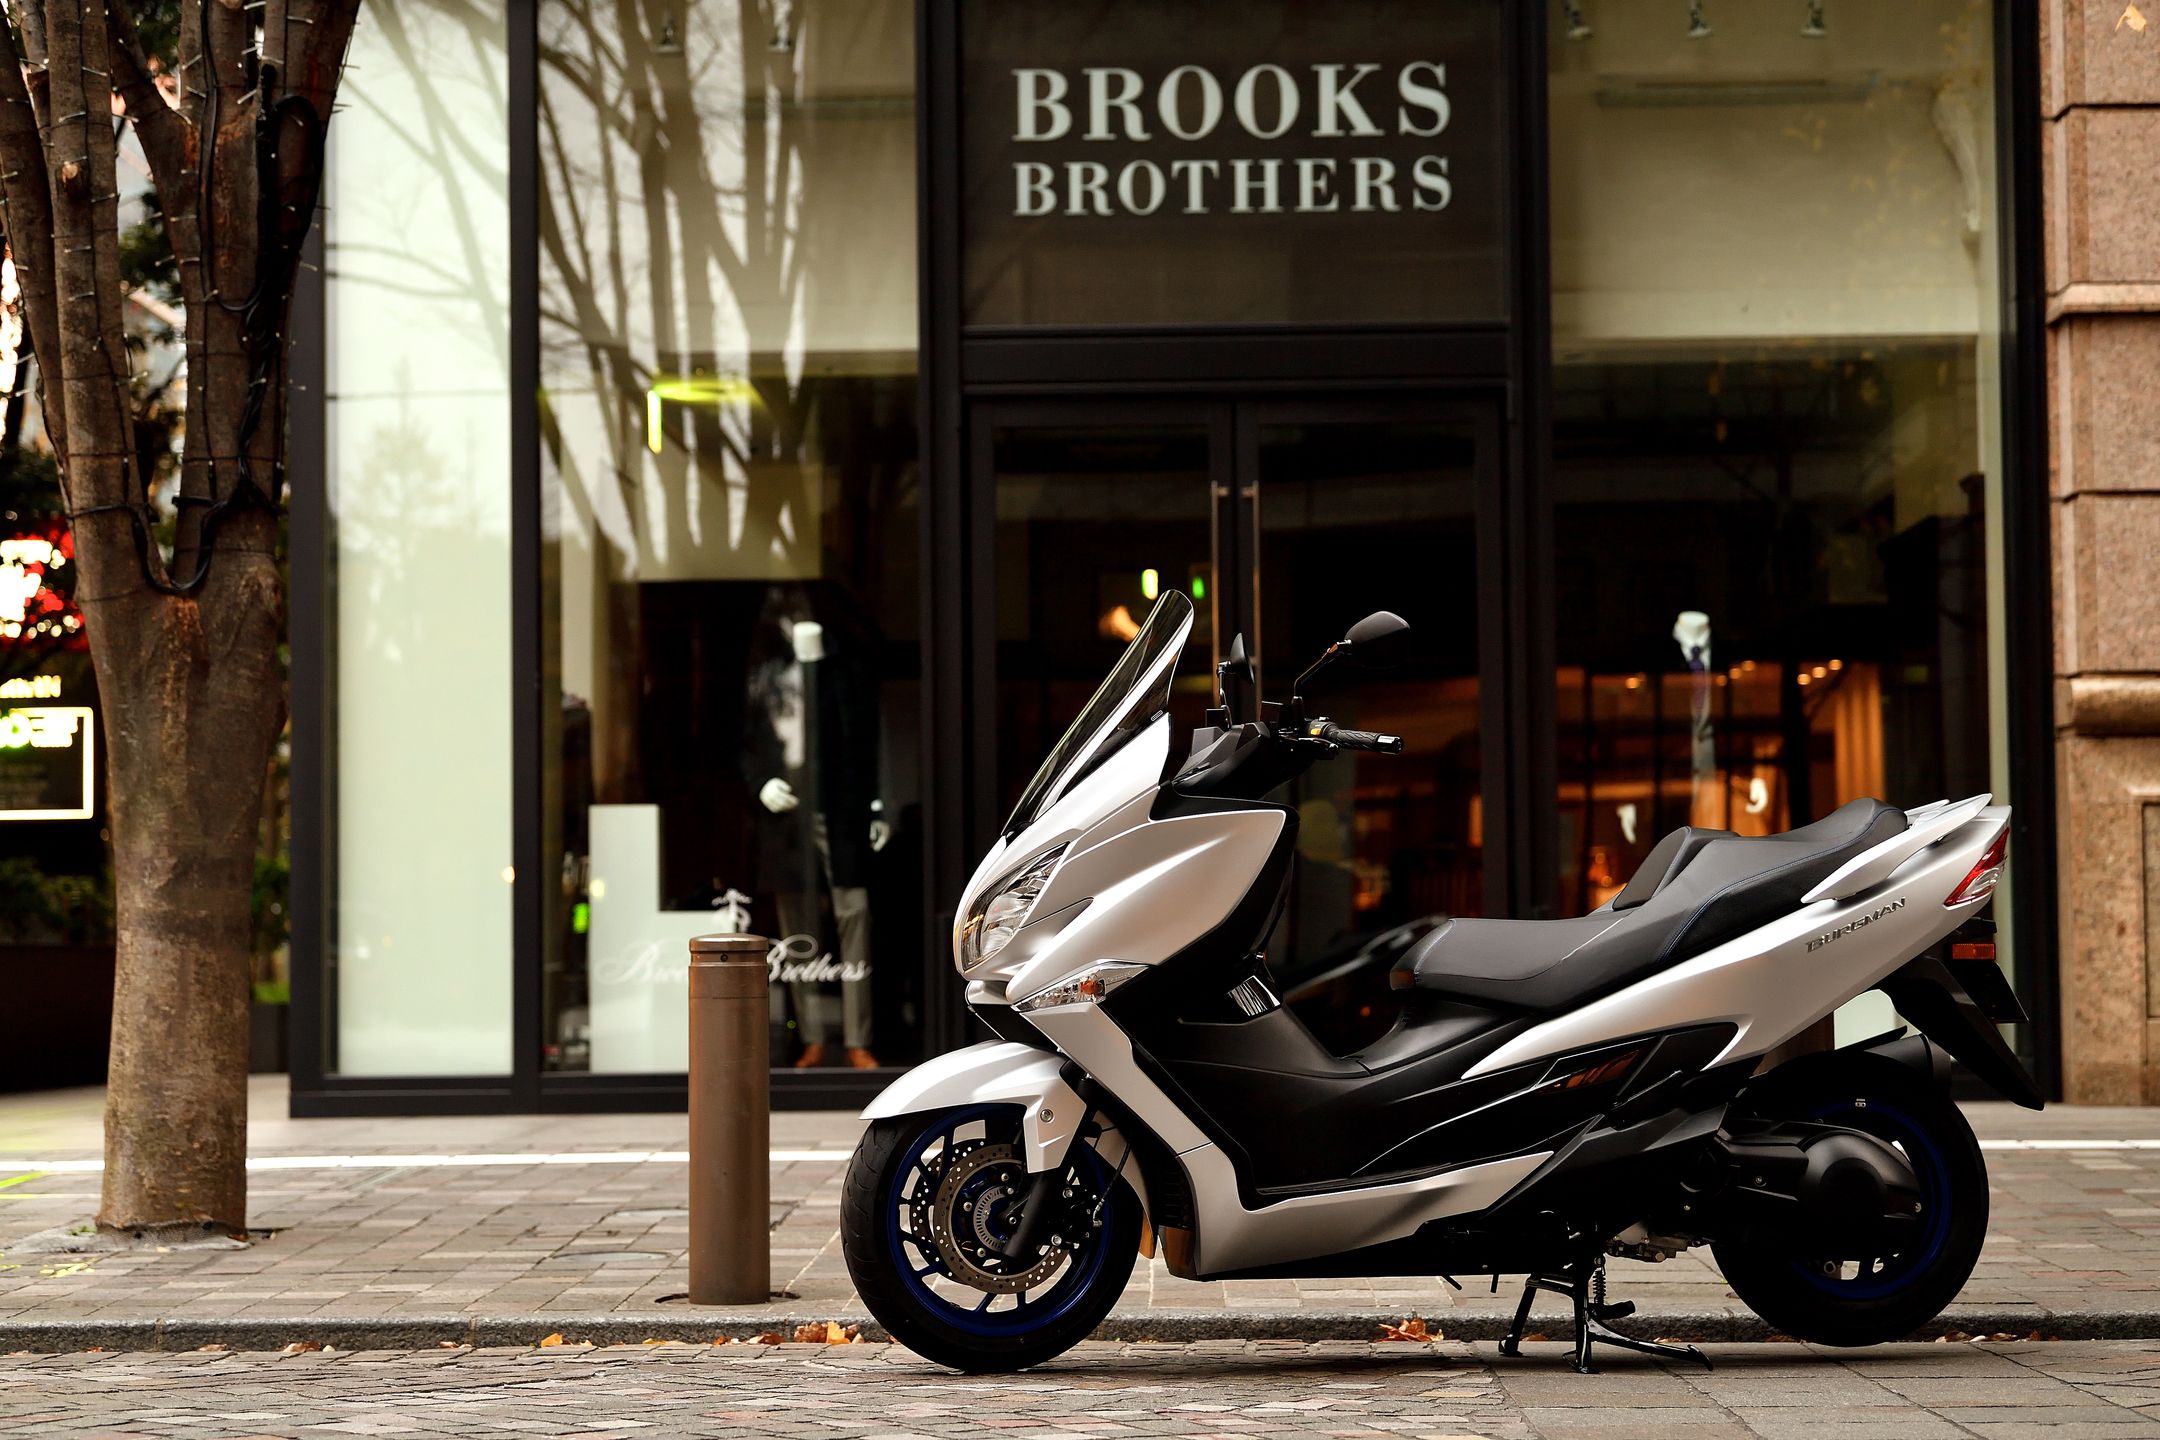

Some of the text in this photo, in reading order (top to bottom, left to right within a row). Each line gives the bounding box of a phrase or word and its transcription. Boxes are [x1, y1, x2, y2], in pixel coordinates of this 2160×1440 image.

[1012, 61, 1451, 141] BROOKS
[1012, 155, 1452, 216] BROTHERS
[1805, 896, 1905, 953] BURGMAN
